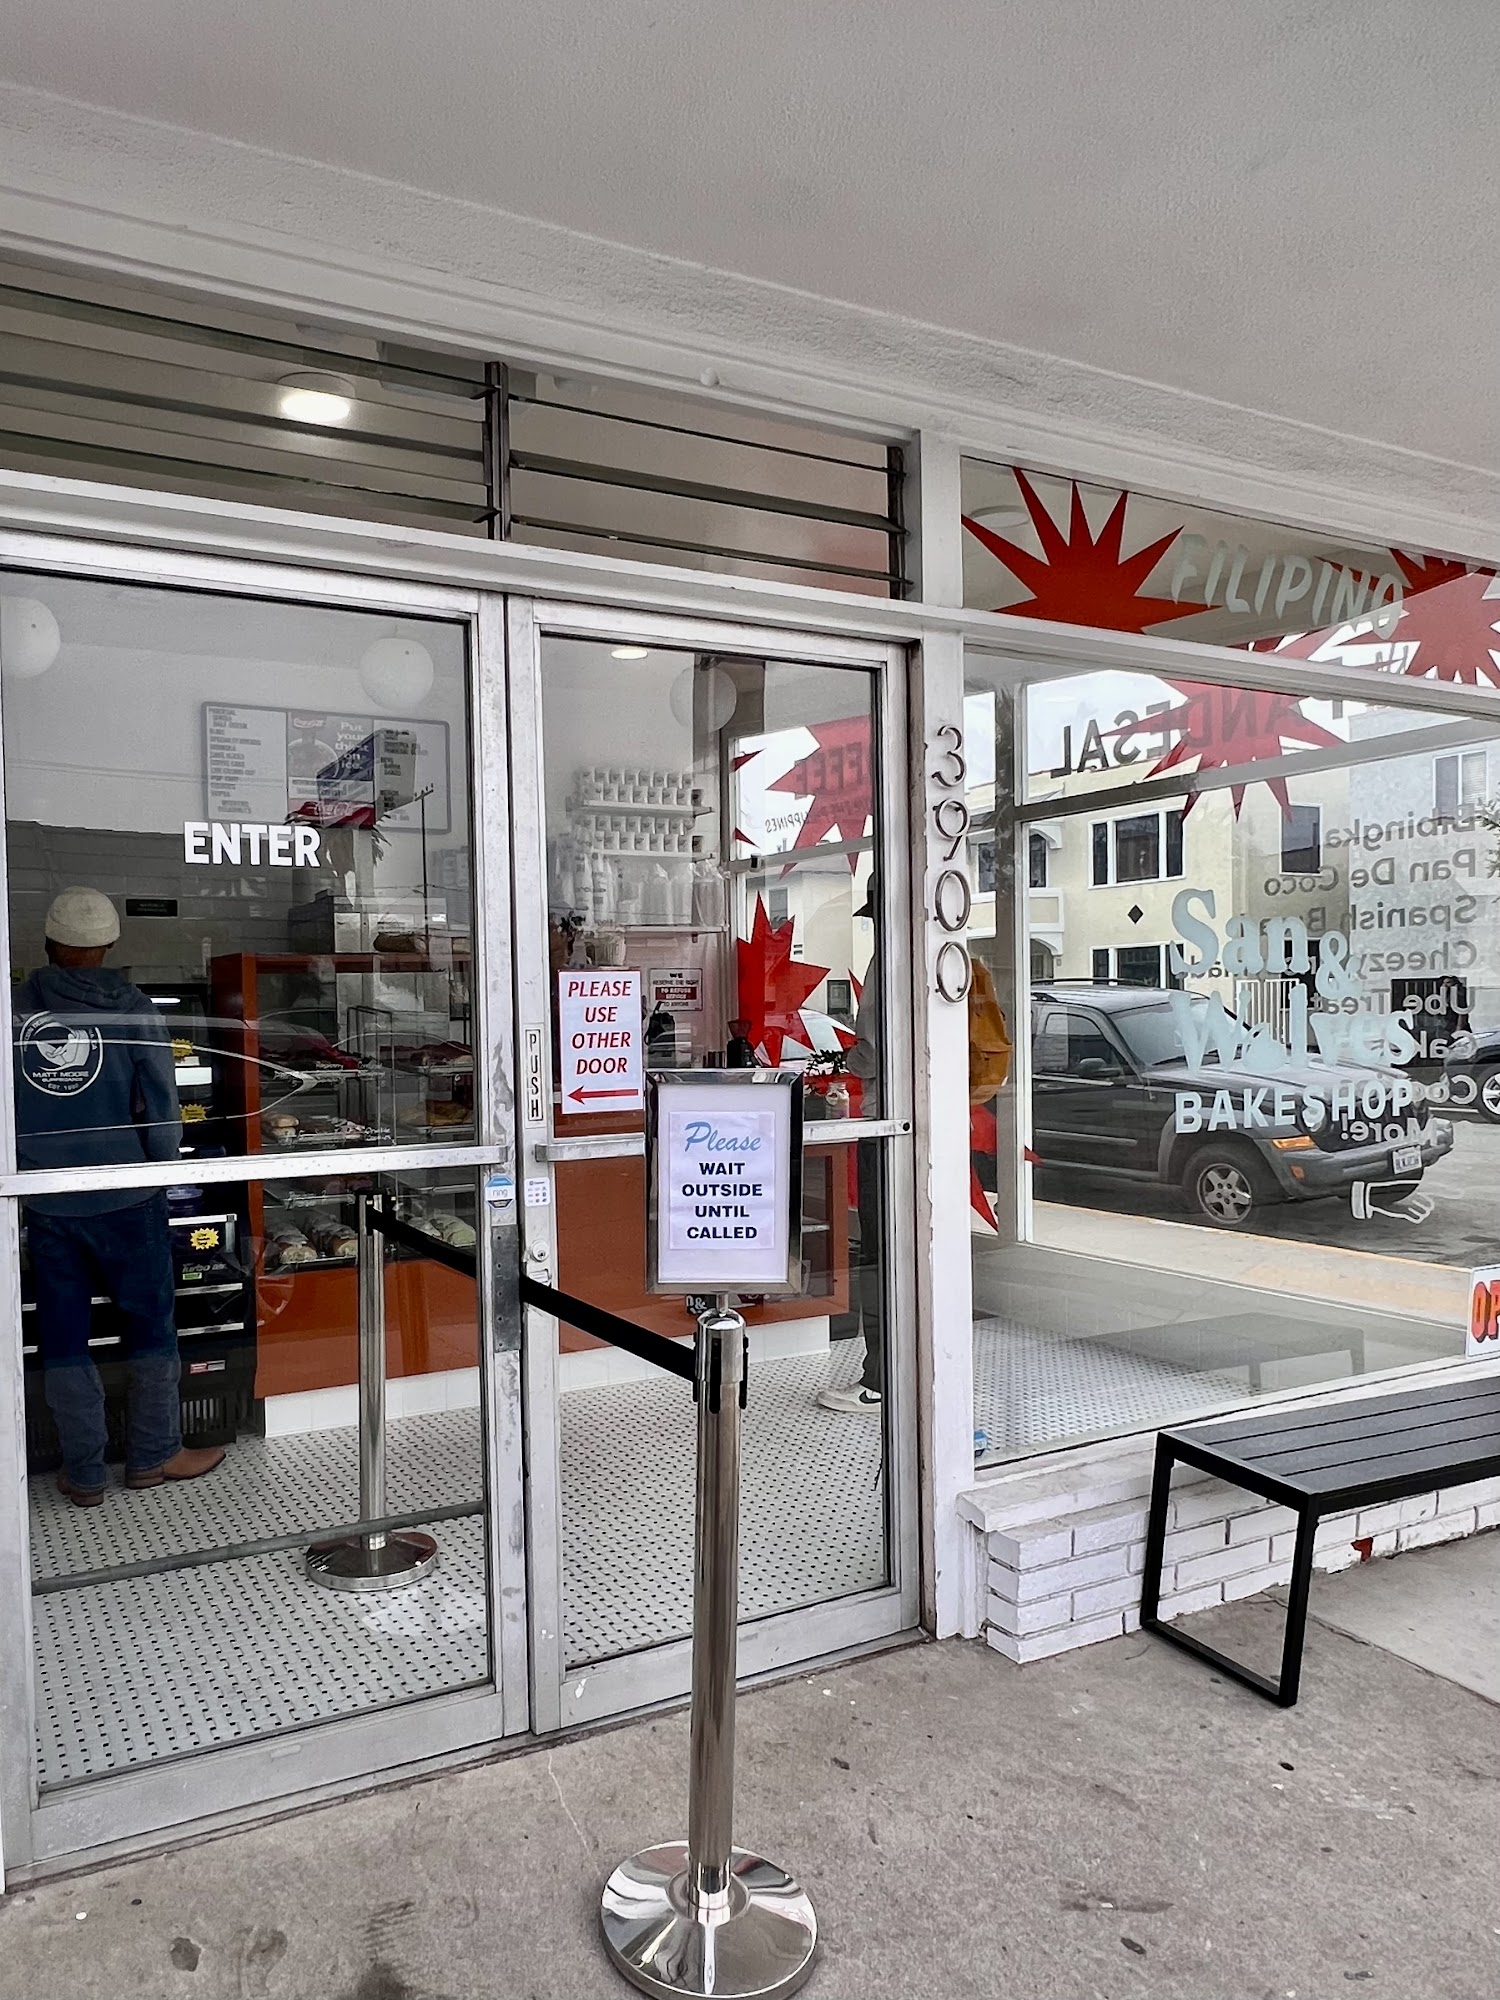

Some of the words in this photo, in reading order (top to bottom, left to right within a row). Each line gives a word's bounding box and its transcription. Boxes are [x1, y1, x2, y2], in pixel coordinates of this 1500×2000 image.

[1171, 534, 1403, 640] FILIPINO
[340, 721, 364, 731] Put
[184, 821, 321, 867] ENTER
[932, 725, 971, 1002] 3900
[1169, 889, 1310, 979] San
[1315, 930, 1363, 999] &
[568, 981, 632, 997] PLEASE
[585, 1006, 617, 1023] USE
[572, 1031, 631, 1049] OTHER
[529, 1033, 539, 1117] PUSH
[576, 1057, 628, 1075] DOOR
[1174, 1078, 1414, 1134] BAKESHOP
[684, 1121, 761, 1152] Please
[699, 1162, 745, 1175] WAIT
[492, 1188, 508, 1198] ring
[682, 1184, 762, 1197] OUTSIDE
[695, 1205, 750, 1218] UNTIL
[687, 1226, 757, 1239] CALLED
